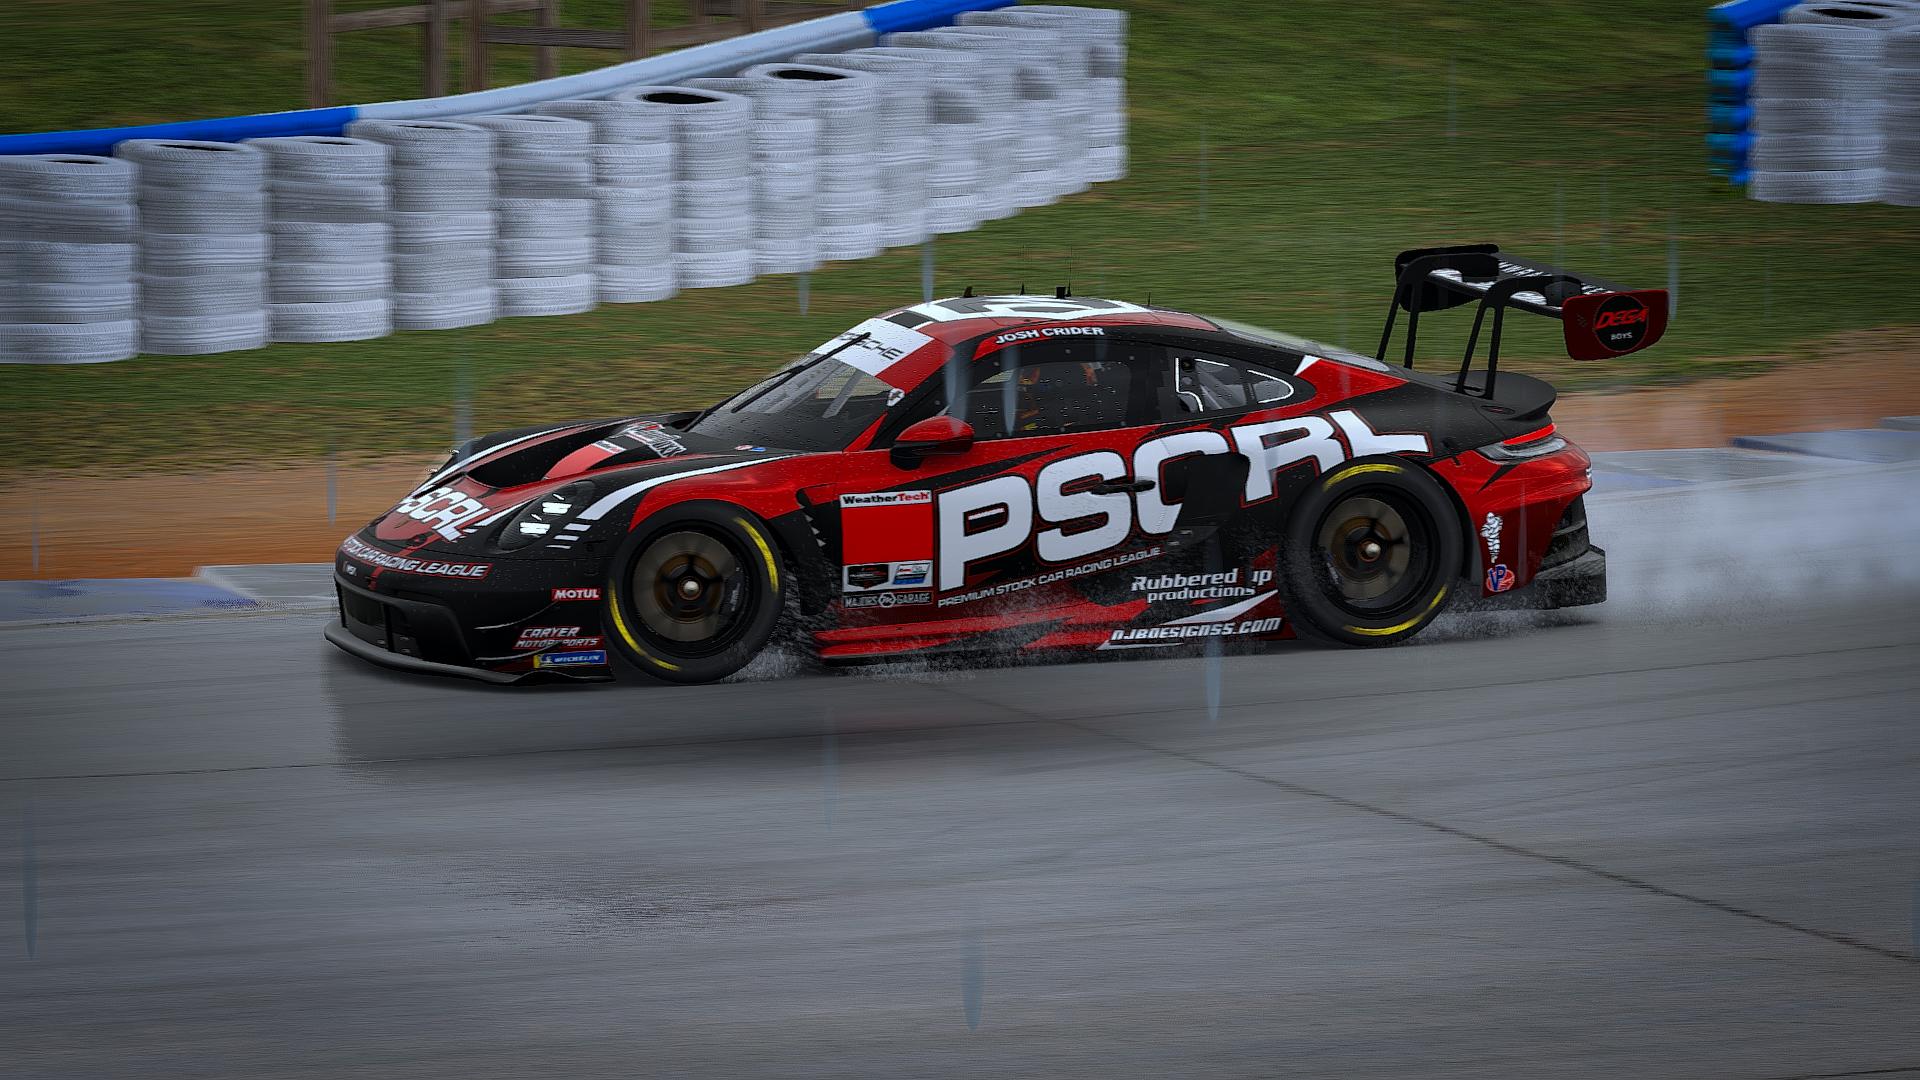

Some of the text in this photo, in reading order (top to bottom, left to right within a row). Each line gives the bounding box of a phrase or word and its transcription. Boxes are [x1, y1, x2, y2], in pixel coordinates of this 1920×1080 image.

[1594, 307, 1649, 330] DEGA
[995, 326, 1105, 345] JOSH CRIDER
[1610, 332, 1633, 341] BOYS
[842, 491, 930, 504] WeatherTech
[938, 408, 1430, 593] PSCRL
[374, 553, 421, 572] RACING
[416, 561, 490, 577] LEAGUE
[937, 547, 1161, 608] PREMIUM STOCK CAR RACING LEAGUE
[1130, 568, 1240, 592] Rubbered
[1487, 564, 1508, 591] VP
[553, 589, 600, 599] MOTUL
[1147, 585, 1256, 604] productions
